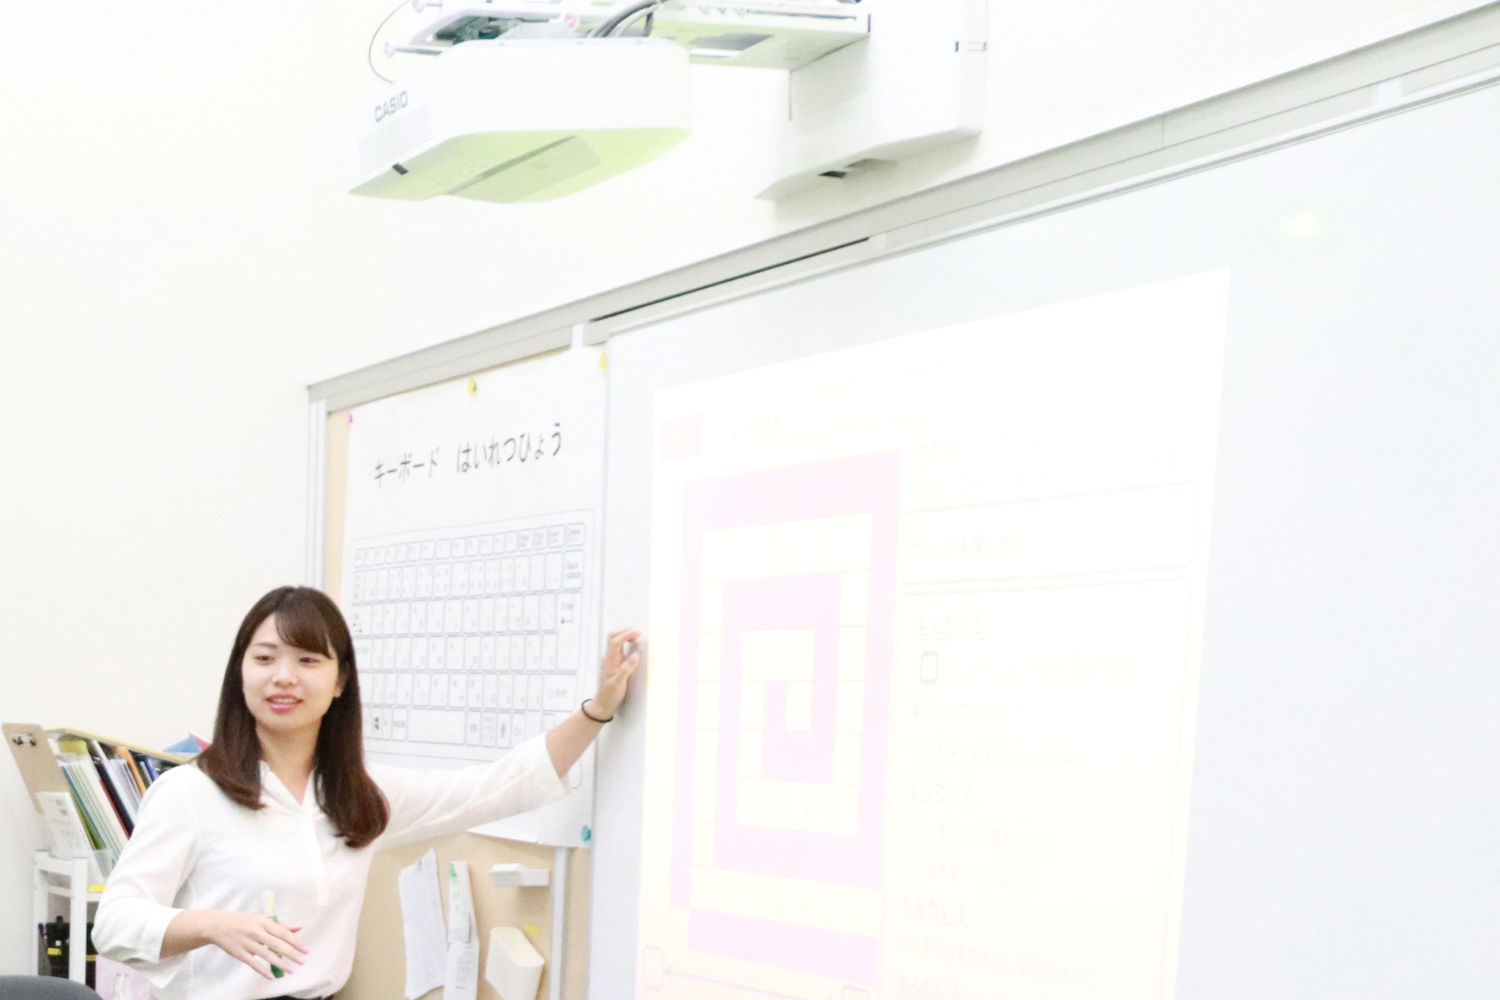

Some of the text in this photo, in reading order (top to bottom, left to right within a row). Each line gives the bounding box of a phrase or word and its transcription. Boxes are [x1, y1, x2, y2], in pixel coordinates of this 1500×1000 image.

[374, 90, 409, 122] CASIO
[375, 421, 563, 488] キーボード はいれつひょう
